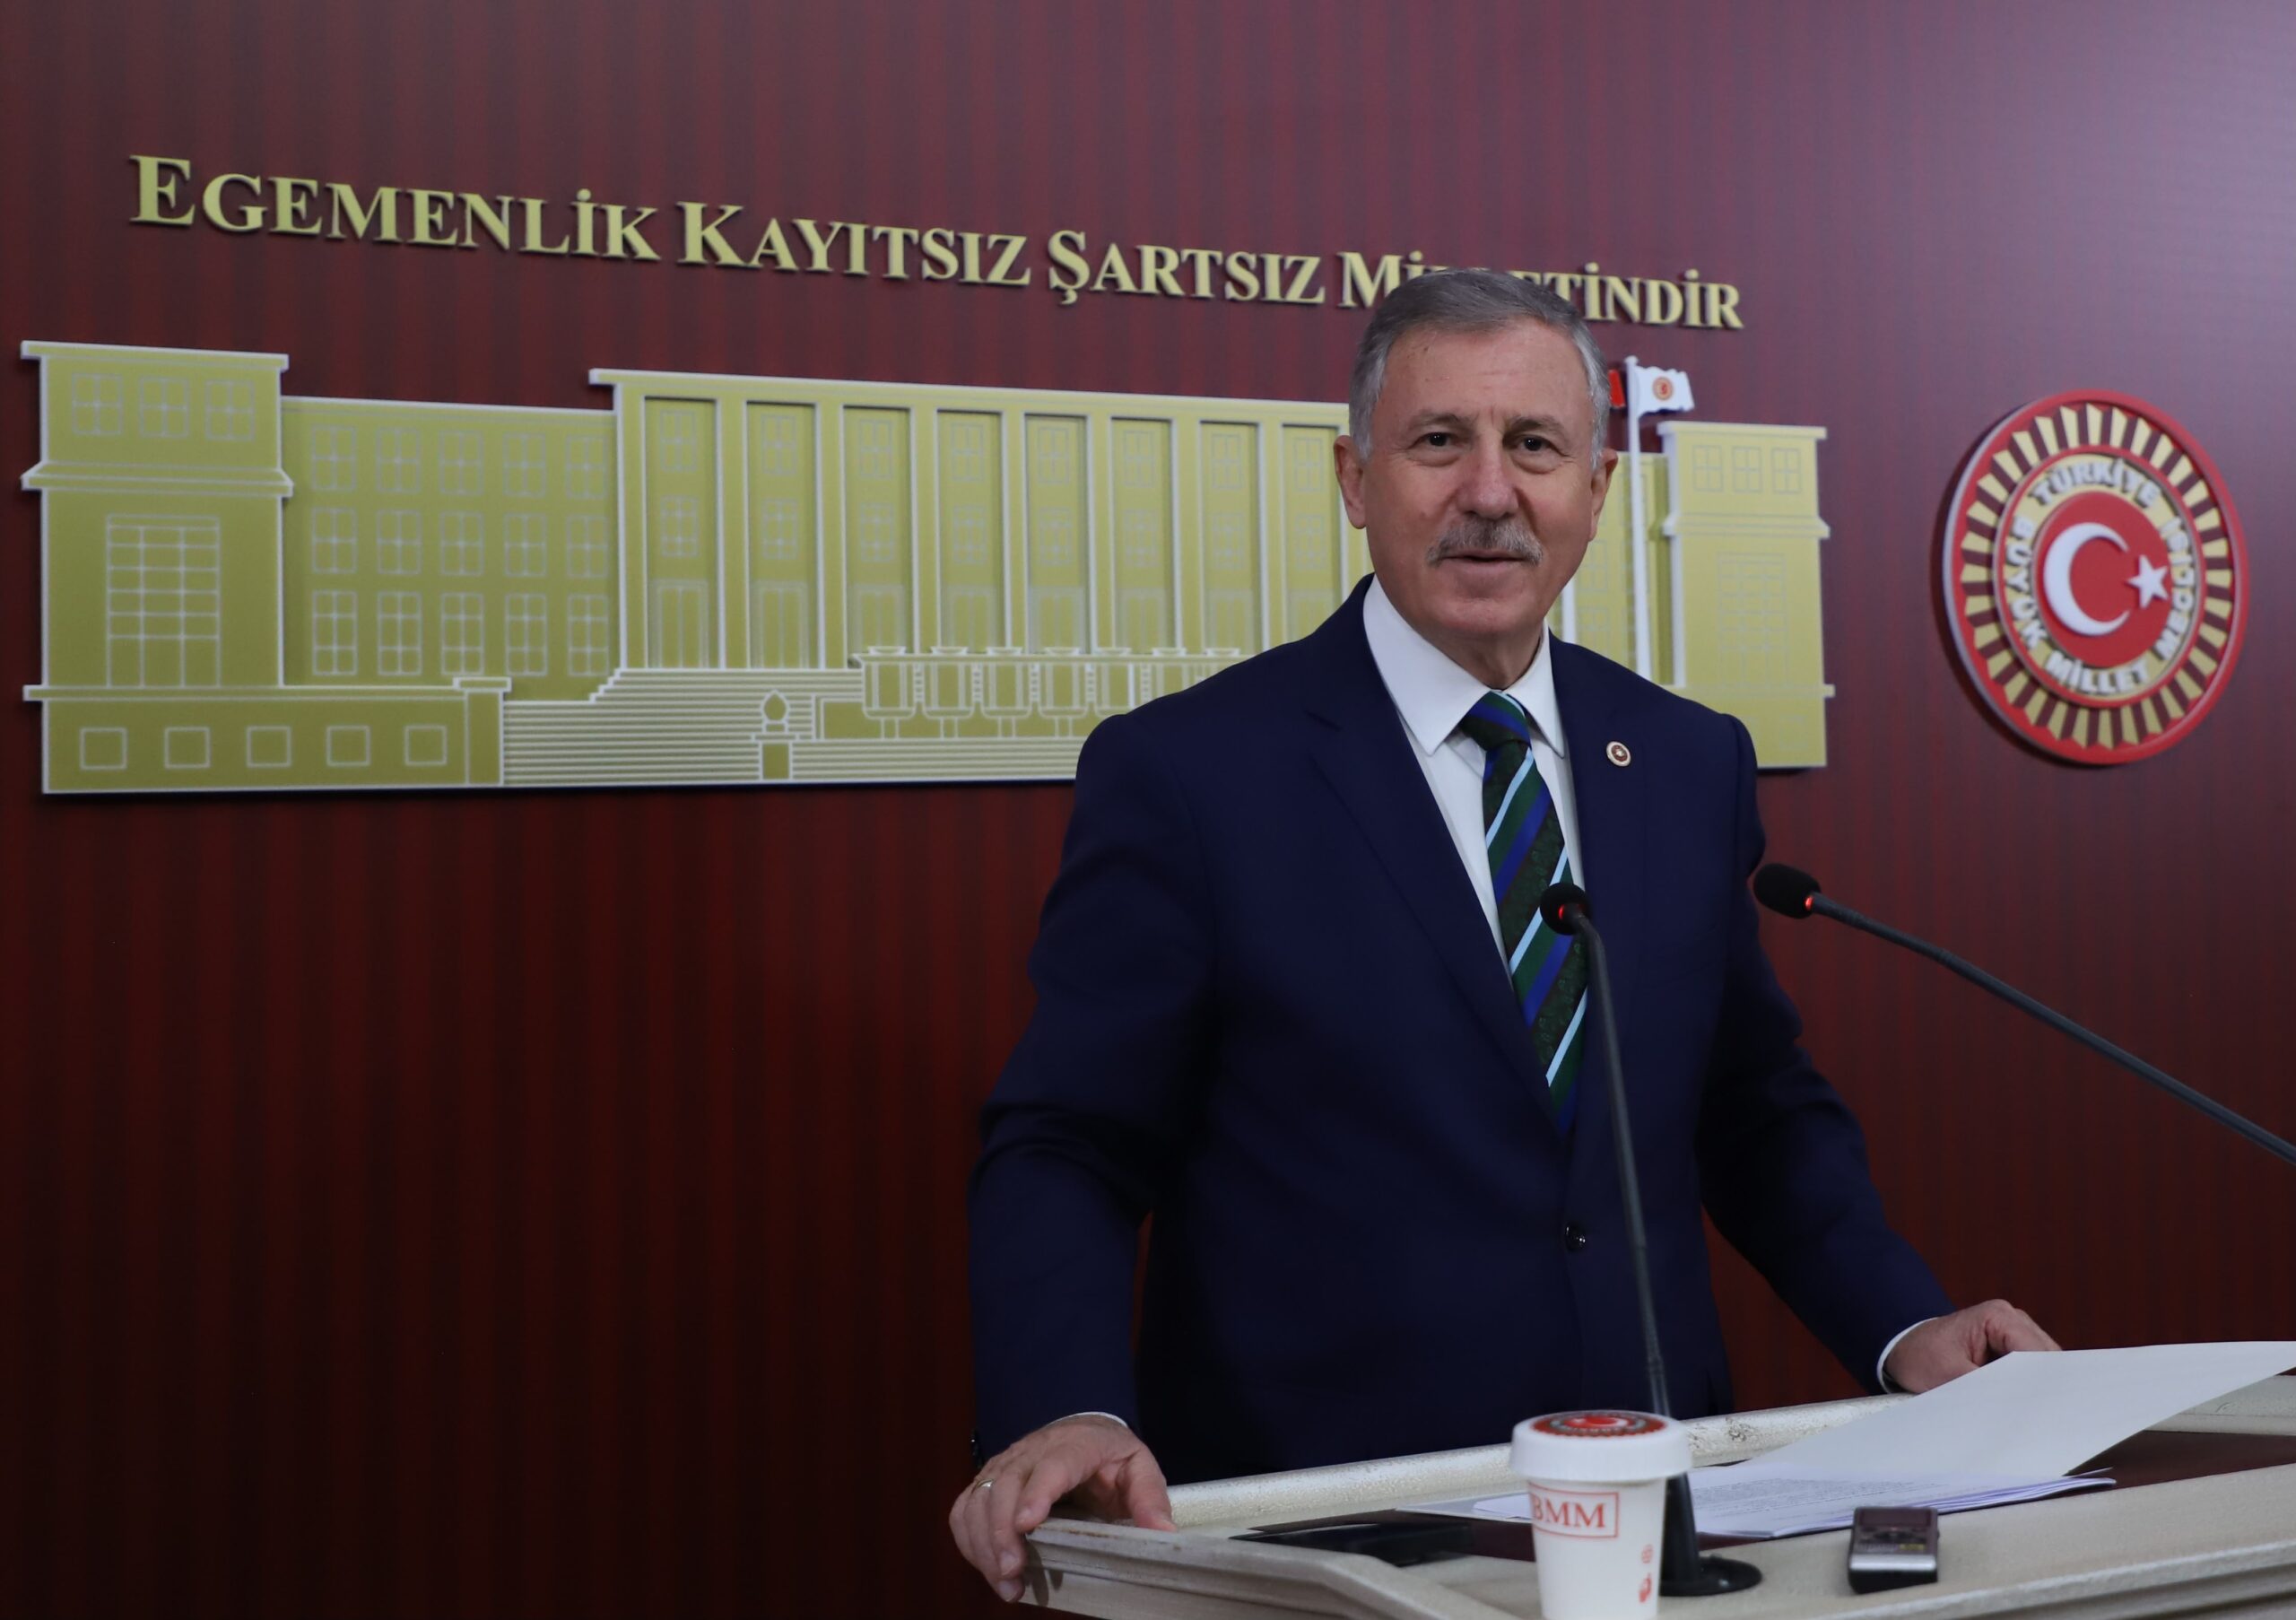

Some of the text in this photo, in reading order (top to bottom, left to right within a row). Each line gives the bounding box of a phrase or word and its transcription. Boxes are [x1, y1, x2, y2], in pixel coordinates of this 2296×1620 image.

[130, 155, 660, 262] EGEMENLİK
[676, 201, 1032, 287] KAYITSIZ
[1048, 230, 1326, 305] ŞARTSIZ
